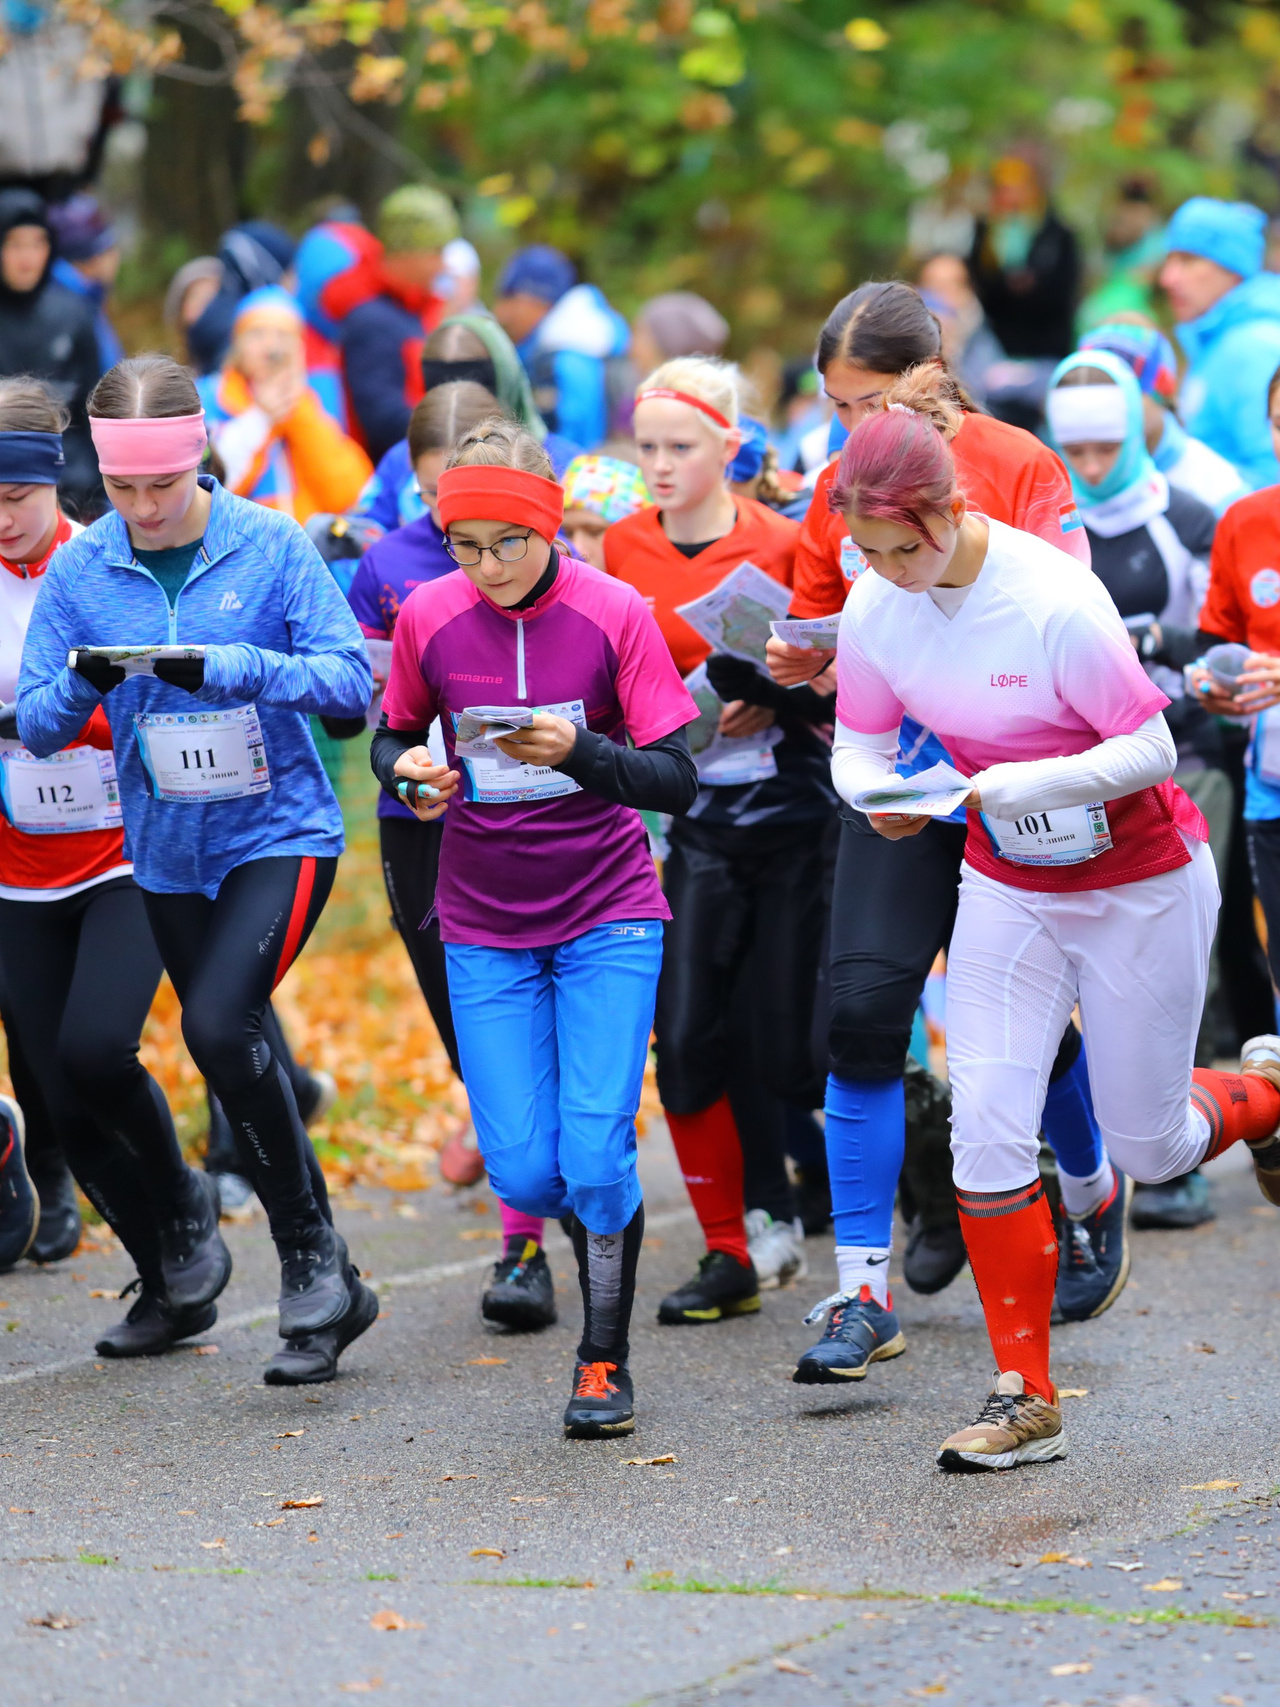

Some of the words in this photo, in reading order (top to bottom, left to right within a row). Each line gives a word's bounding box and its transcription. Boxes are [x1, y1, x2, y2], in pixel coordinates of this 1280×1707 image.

[448, 672, 503, 684] noname
[180, 748, 216, 770] 111
[523, 769, 530, 777] 5
[37, 785, 75, 804] 112
[1014, 811, 1053, 836] 101
[1037, 837, 1044, 846] 5
[1045, 833, 1076, 845] линия
